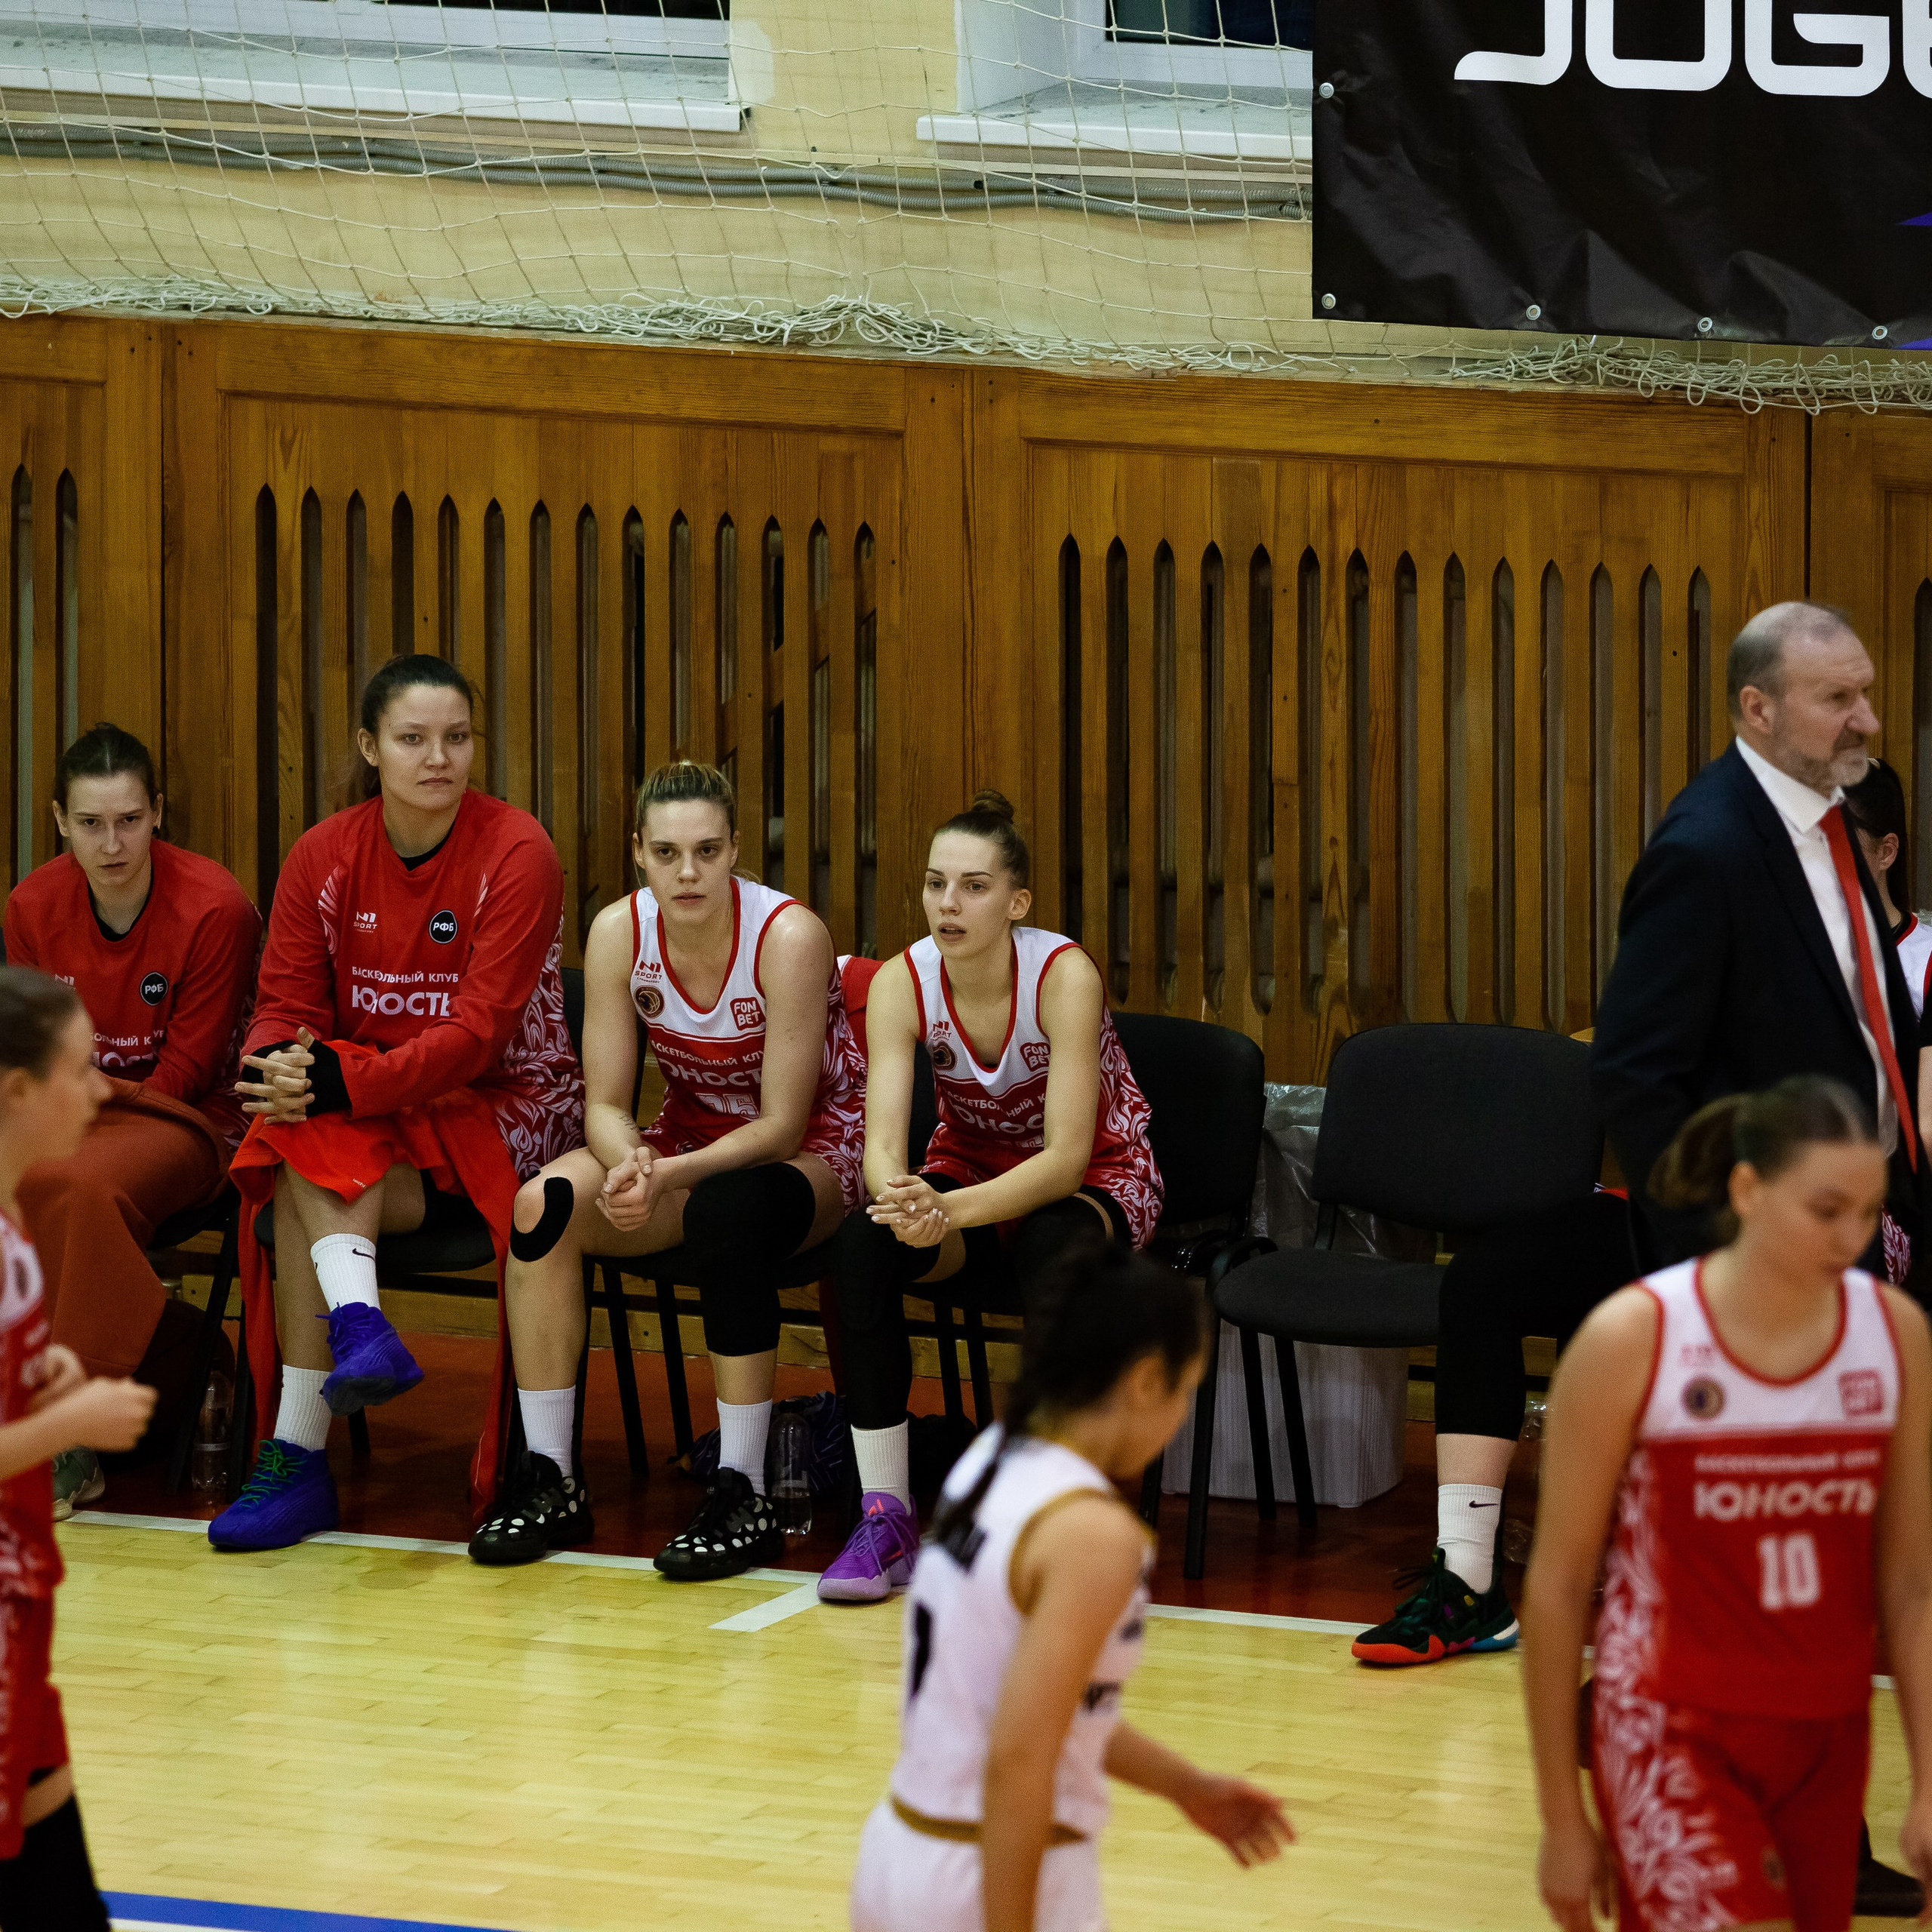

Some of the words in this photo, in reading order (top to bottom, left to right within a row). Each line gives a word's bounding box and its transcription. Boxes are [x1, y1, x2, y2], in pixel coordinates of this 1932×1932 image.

[1454, 0, 1932, 97] JOG
[433, 922, 454, 932] РФБ
[429, 974, 459, 983] КЛУБ
[635, 971, 662, 980] SPORT
[145, 983, 164, 995] РФБ
[734, 1001, 757, 1014] FON
[737, 1011, 760, 1026] BET
[1023, 1045, 1049, 1058] FON
[1758, 1531, 1821, 1612] 10
